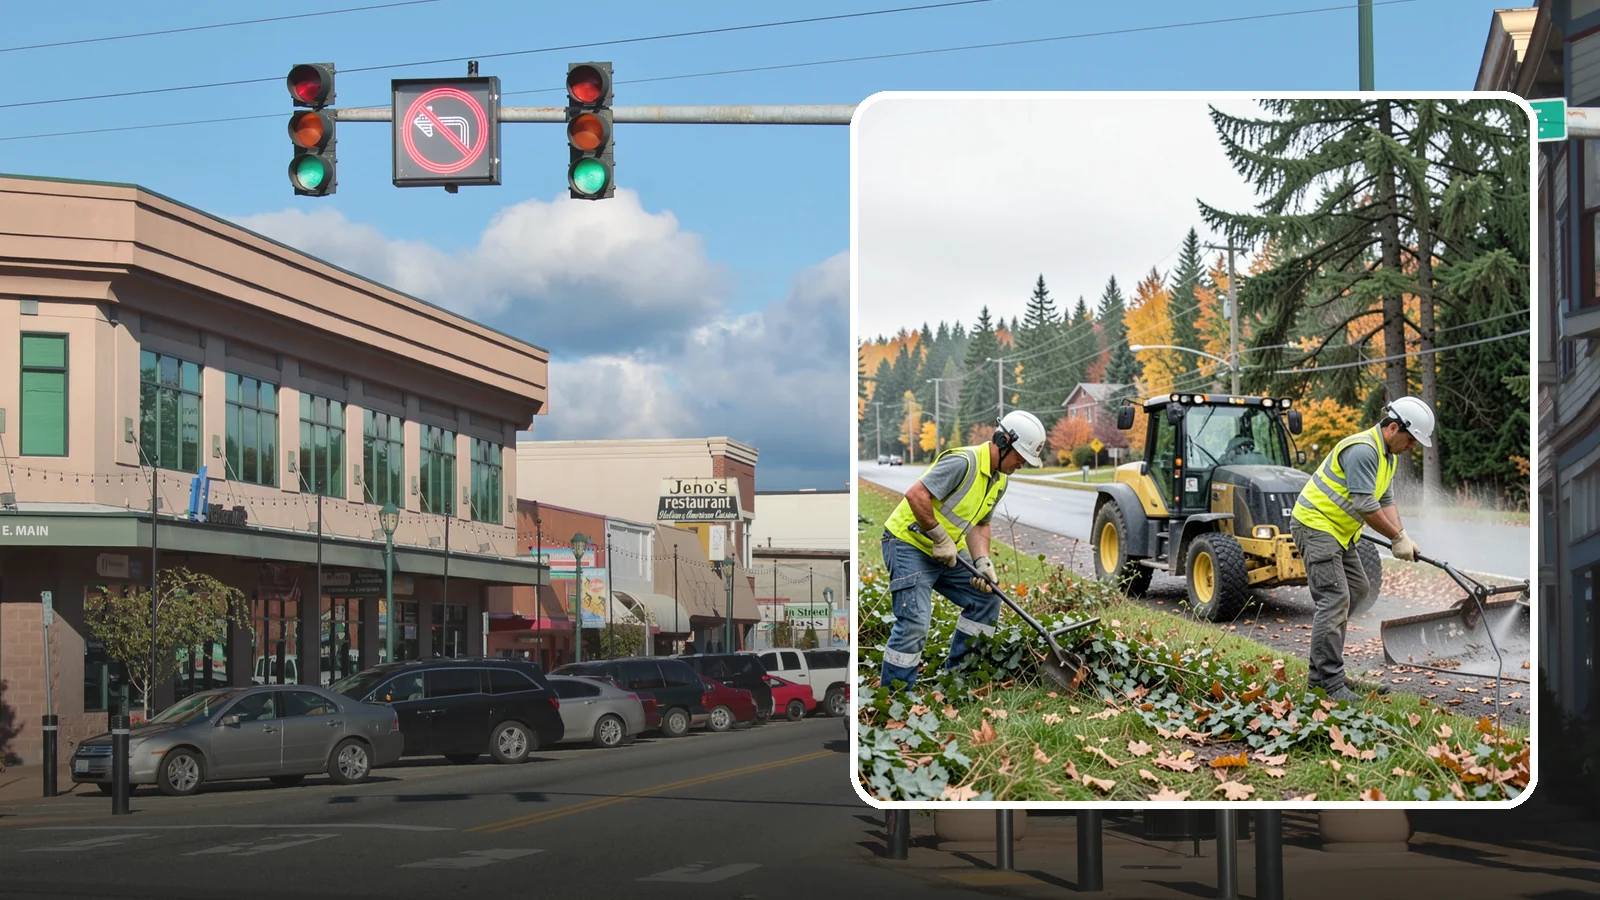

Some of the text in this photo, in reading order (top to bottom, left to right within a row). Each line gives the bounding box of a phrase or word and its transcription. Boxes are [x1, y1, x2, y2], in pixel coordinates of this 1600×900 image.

[669, 480, 728, 495] Jeno's
[665, 496, 731, 509] restaurant
[658, 509, 682, 519] Italian
[685, 509, 715, 519] American
[715, 509, 738, 519] Cuisine
[2, 525, 49, 536] E. MAIN
[797, 607, 828, 617] Street
[791, 619, 824, 627] lass
